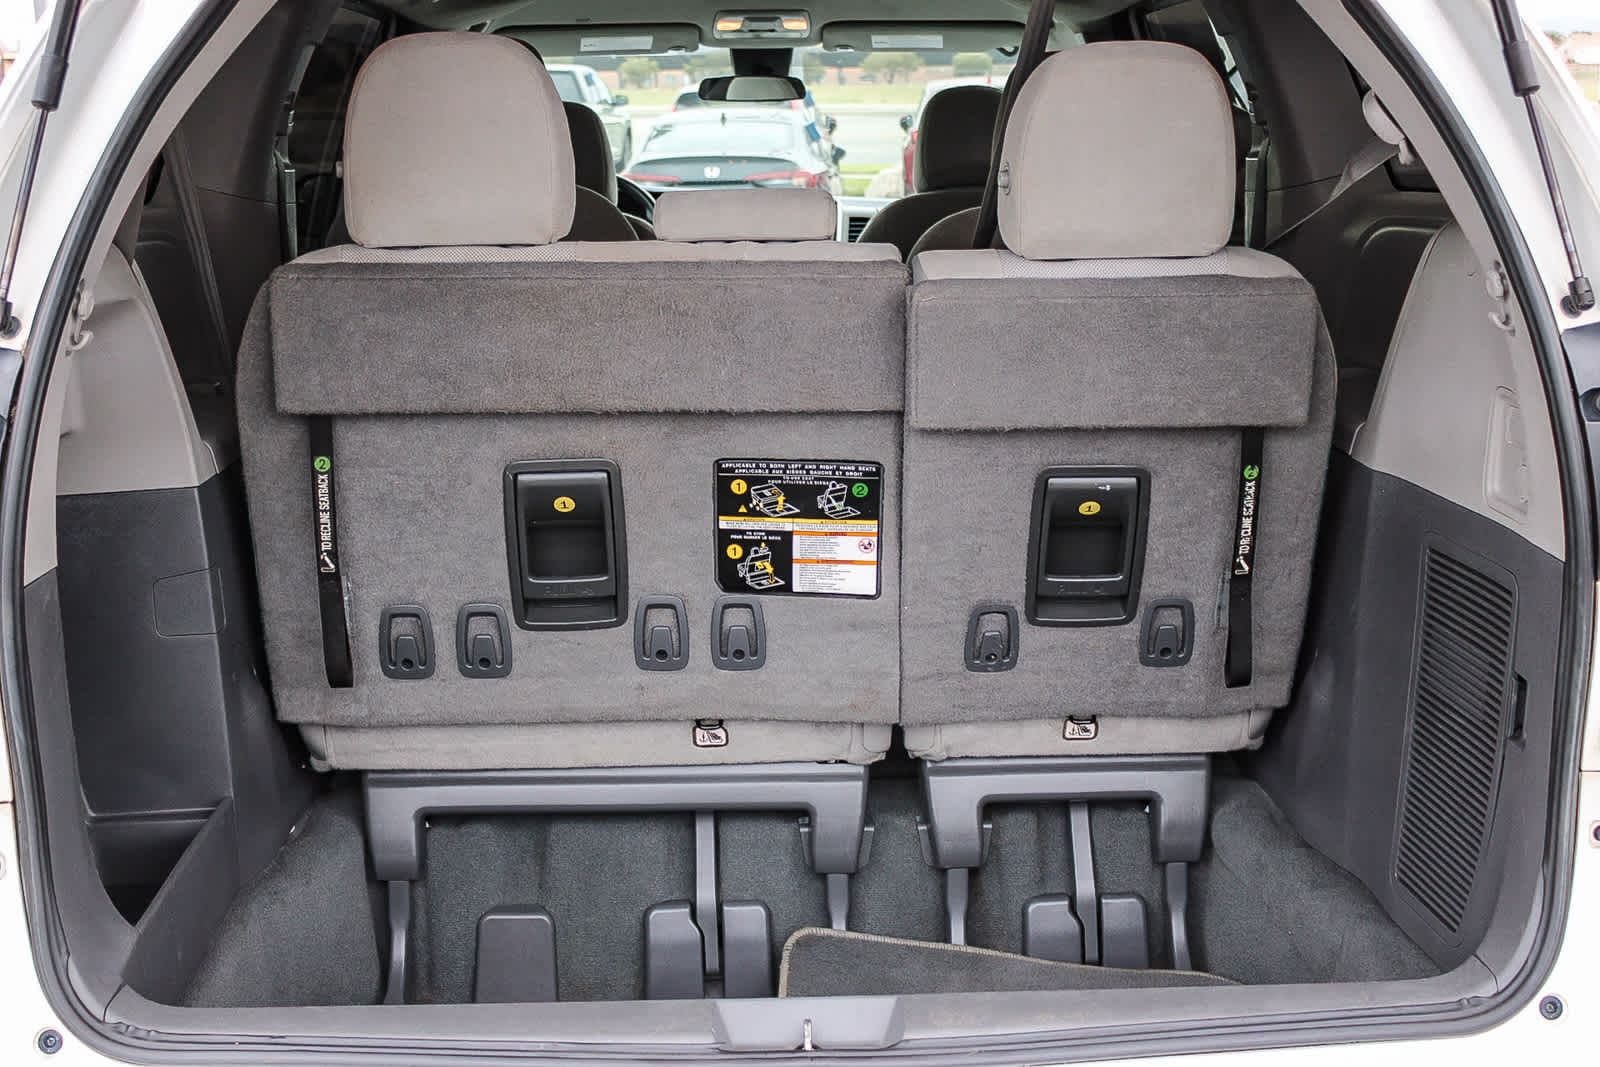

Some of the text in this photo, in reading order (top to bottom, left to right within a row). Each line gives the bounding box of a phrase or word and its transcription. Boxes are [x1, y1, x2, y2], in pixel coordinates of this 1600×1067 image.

[318, 474, 332, 551] TO RECLINE SEATBACK
[1238, 545, 1249, 554] TO
